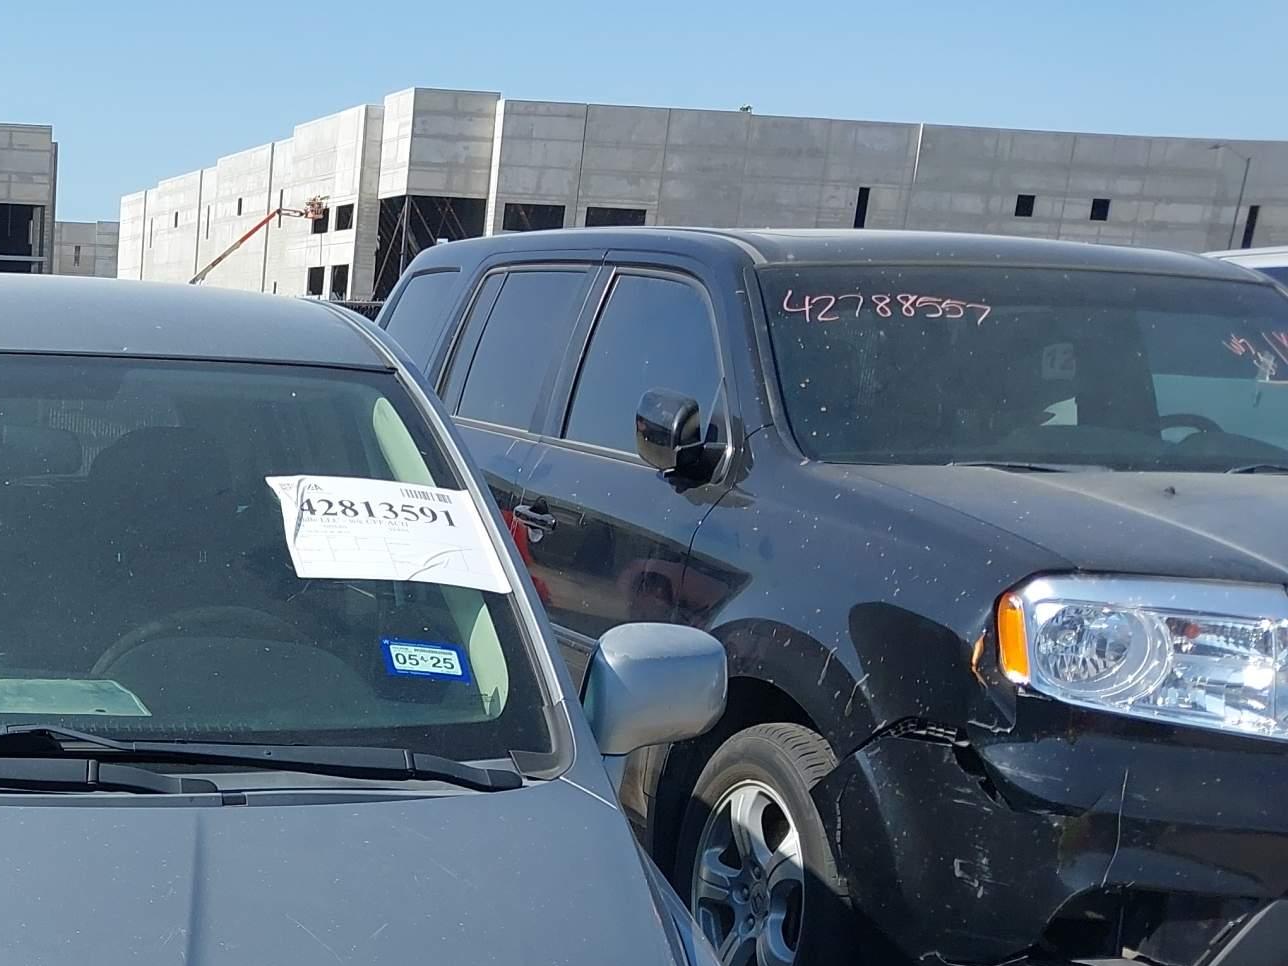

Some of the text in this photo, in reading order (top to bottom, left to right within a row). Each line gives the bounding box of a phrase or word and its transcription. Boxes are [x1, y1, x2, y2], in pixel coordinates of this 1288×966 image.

[782, 289, 992, 326] 42788557
[299, 498, 456, 528] 42813591
[394, 652, 455, 670] 05 25
